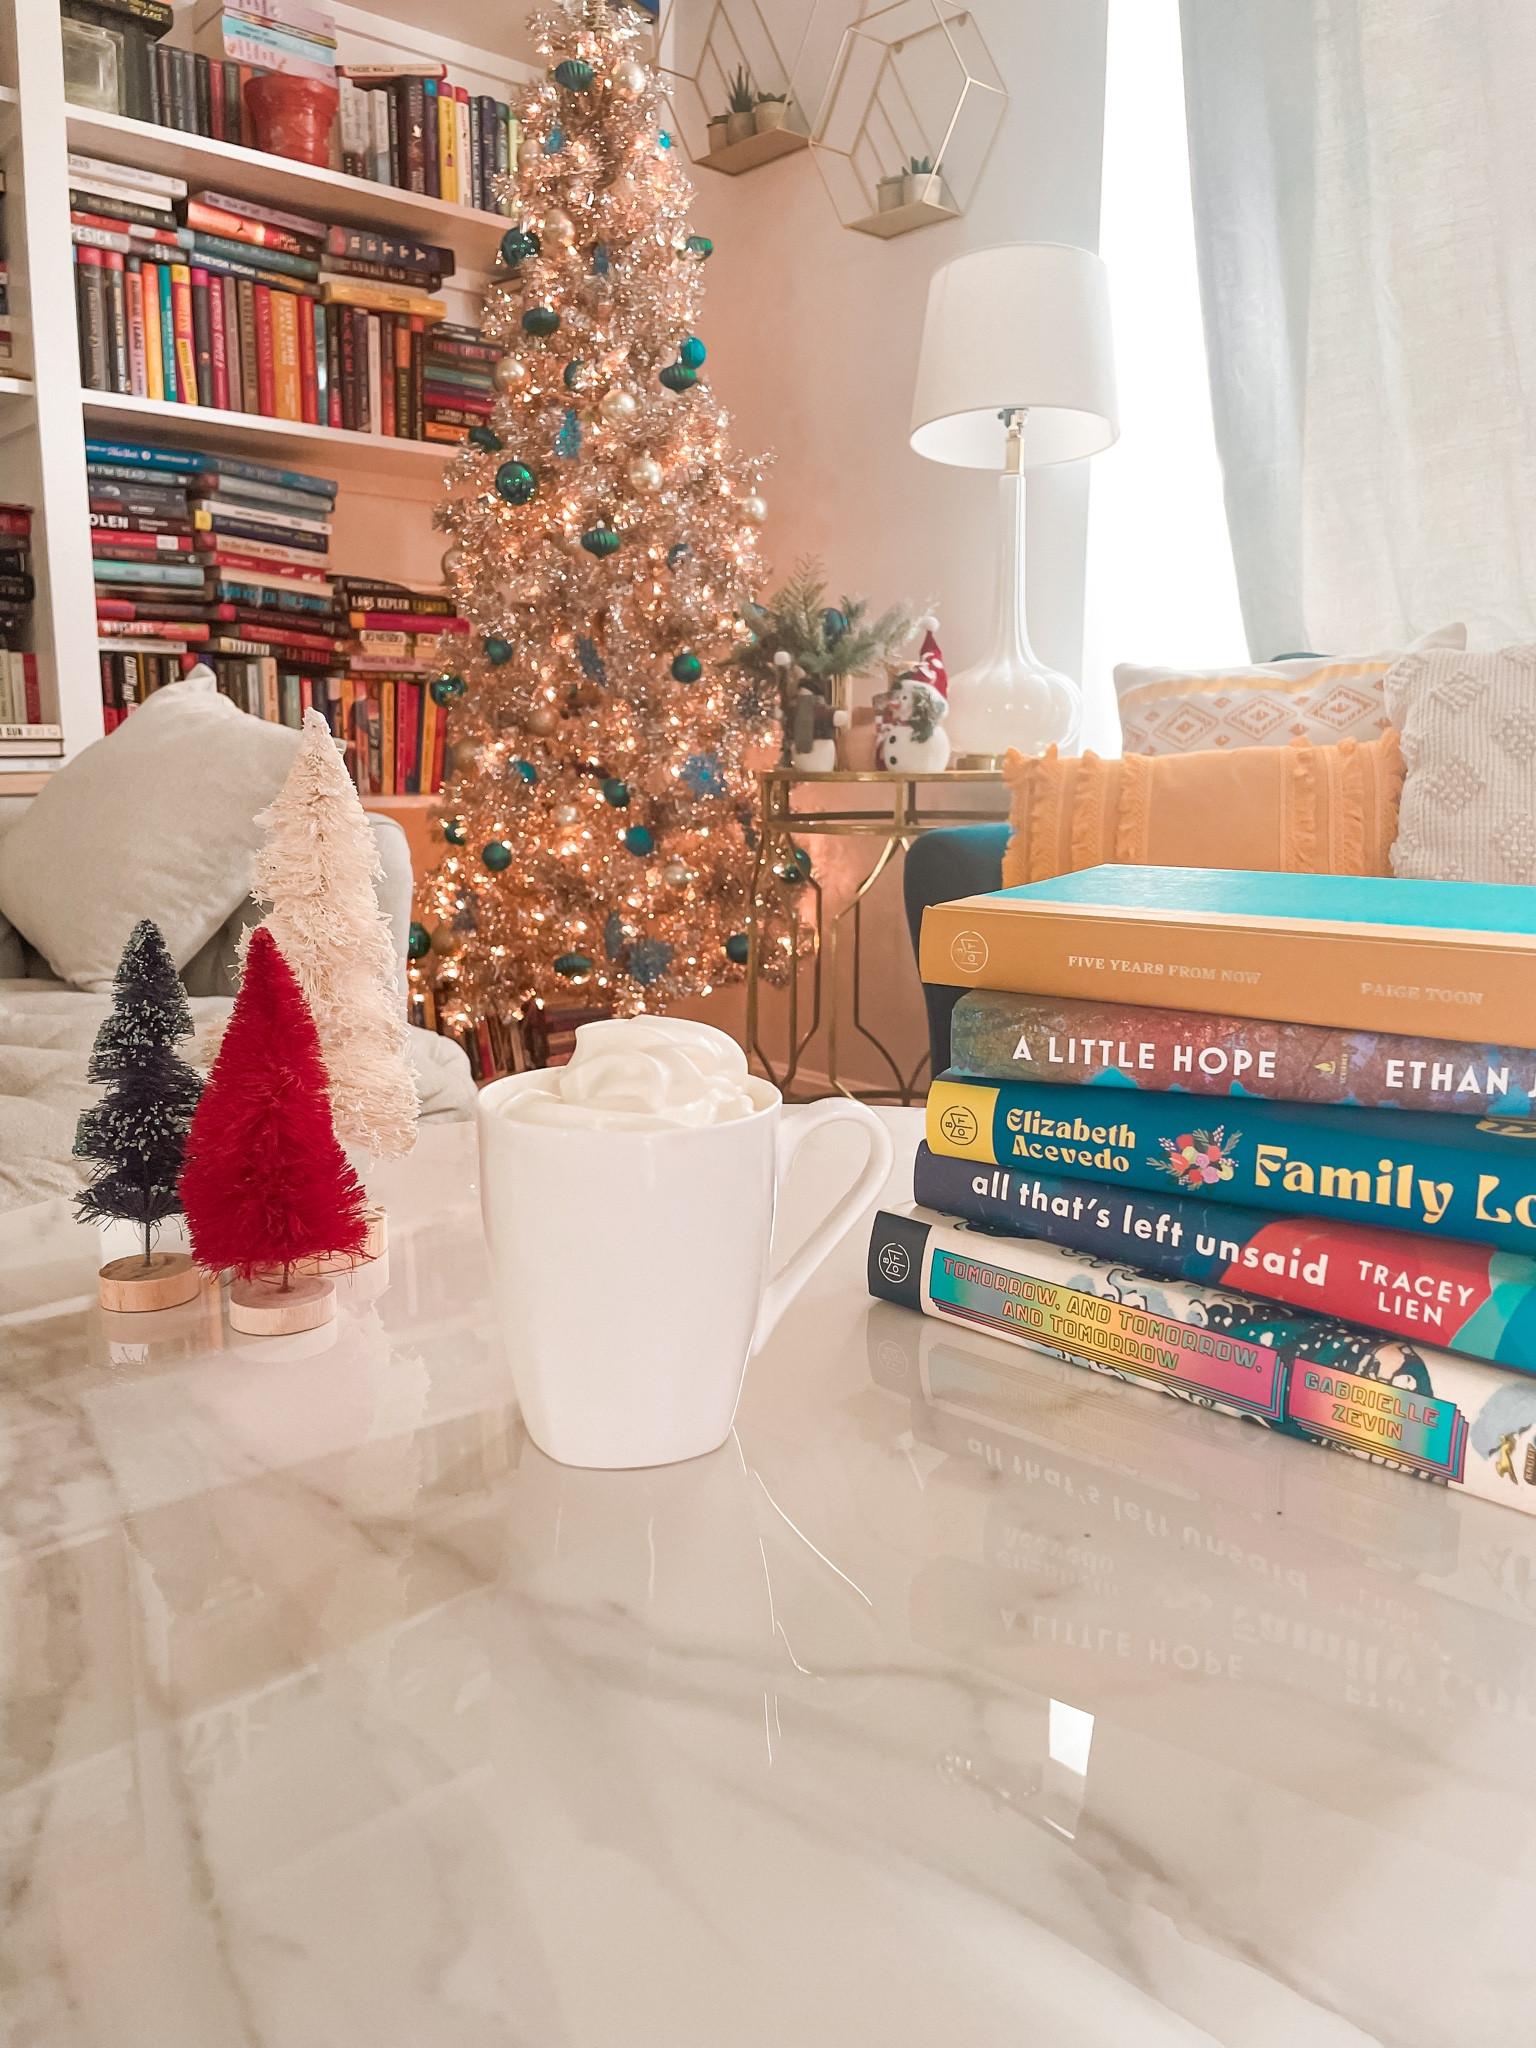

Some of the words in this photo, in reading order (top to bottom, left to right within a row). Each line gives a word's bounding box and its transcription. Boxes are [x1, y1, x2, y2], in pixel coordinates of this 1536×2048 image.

[1067, 955, 1105, 970] FIVE
[1109, 959, 1164, 975] YEARS
[1168, 965, 1216, 981] FROM
[1220, 970, 1262, 985] NOW
[1424, 987, 1484, 1006] TOON
[1012, 1035, 1033, 1061] A
[1048, 1036, 1156, 1070] LITTLE
[1173, 1044, 1277, 1079] HOPE
[1385, 1059, 1509, 1096] ETHAN
[1005, 1107, 1137, 1149] Elizabeth
[1011, 1134, 1131, 1173] Acevedo
[1254, 1143, 1455, 1225] Family
[971, 1171, 1010, 1201] all
[1018, 1181, 1111, 1229] that's
[1122, 1204, 1184, 1248] left
[1195, 1234, 1330, 1287] unsaid
[1357, 1259, 1476, 1308] TRACEY
[1066, 1295, 1113, 1326] AND
[1377, 1291, 1443, 1328] LIEN
[1001, 1299, 1044, 1328] AND
[1048, 1314, 1180, 1371] TOMORROW
[1304, 1371, 1441, 1429] GABRIELLE
[1331, 1402, 1403, 1442] ZEVIN
